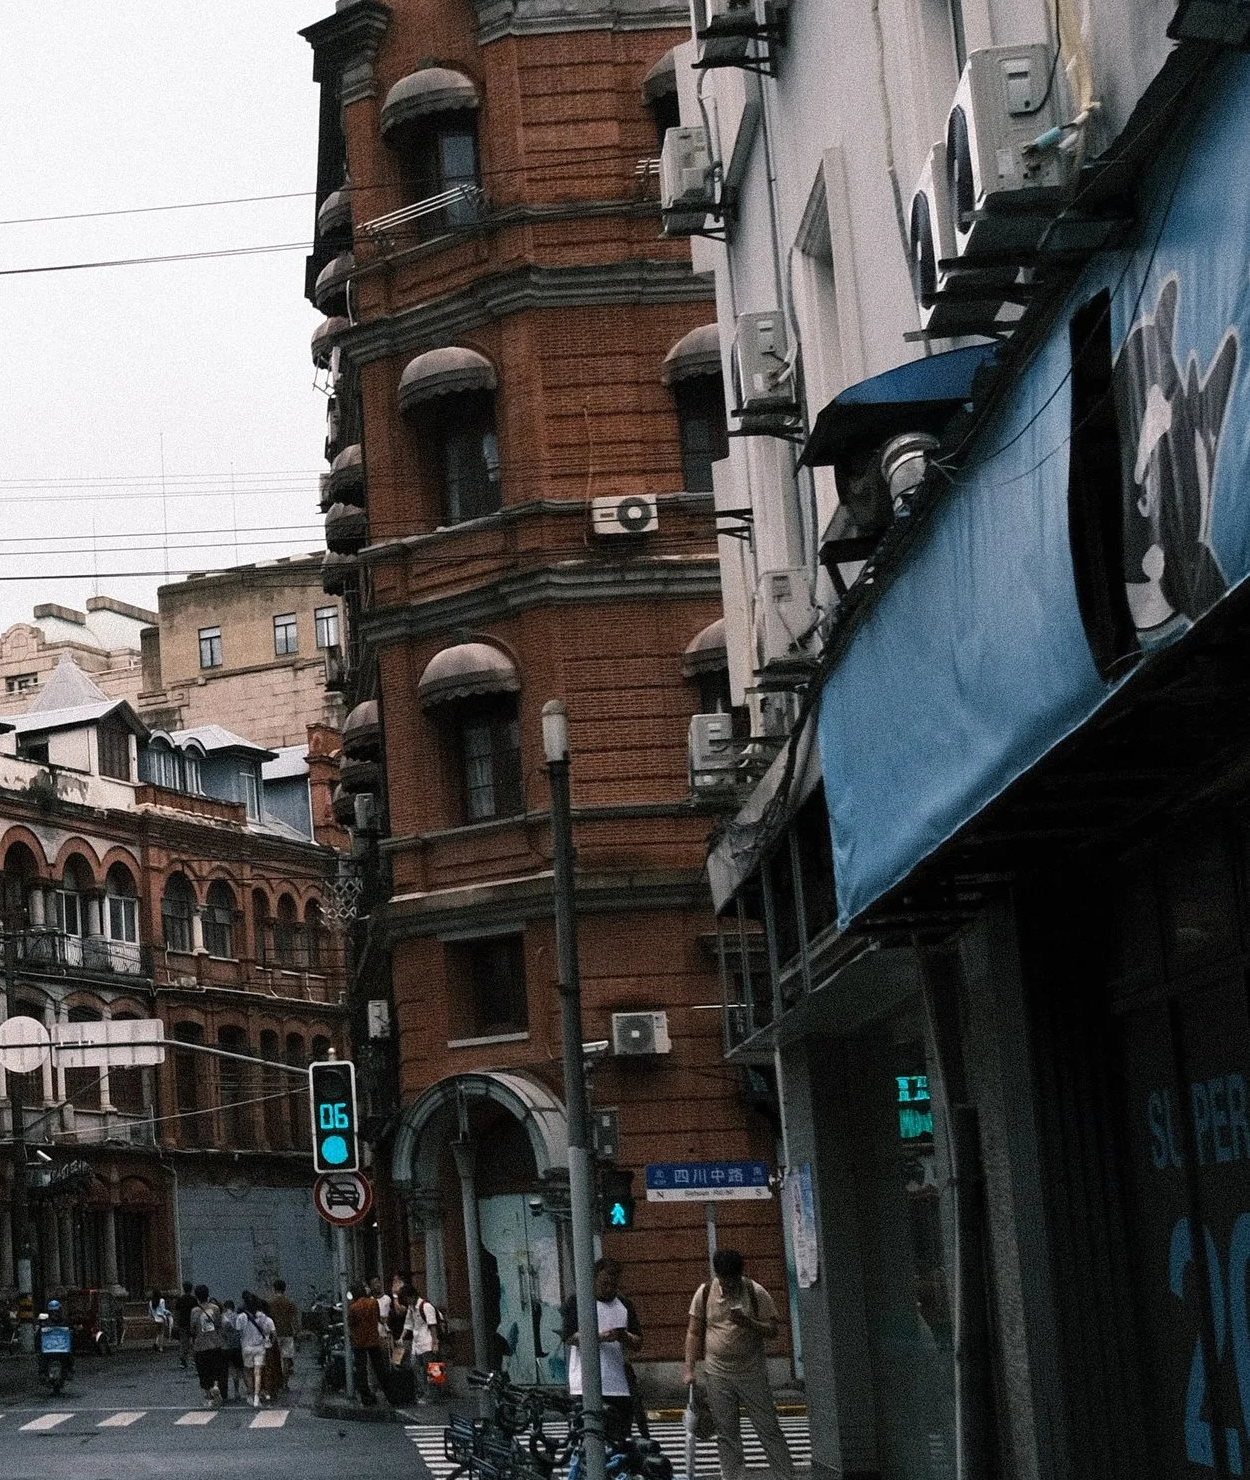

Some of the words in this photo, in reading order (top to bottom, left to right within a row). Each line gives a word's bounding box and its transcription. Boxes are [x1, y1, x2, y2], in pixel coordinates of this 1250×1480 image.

[320, 1103, 349, 1129] 06
[1147, 1074, 1250, 1170] SUPER
[674, 1168, 744, 1184] 四川中路
